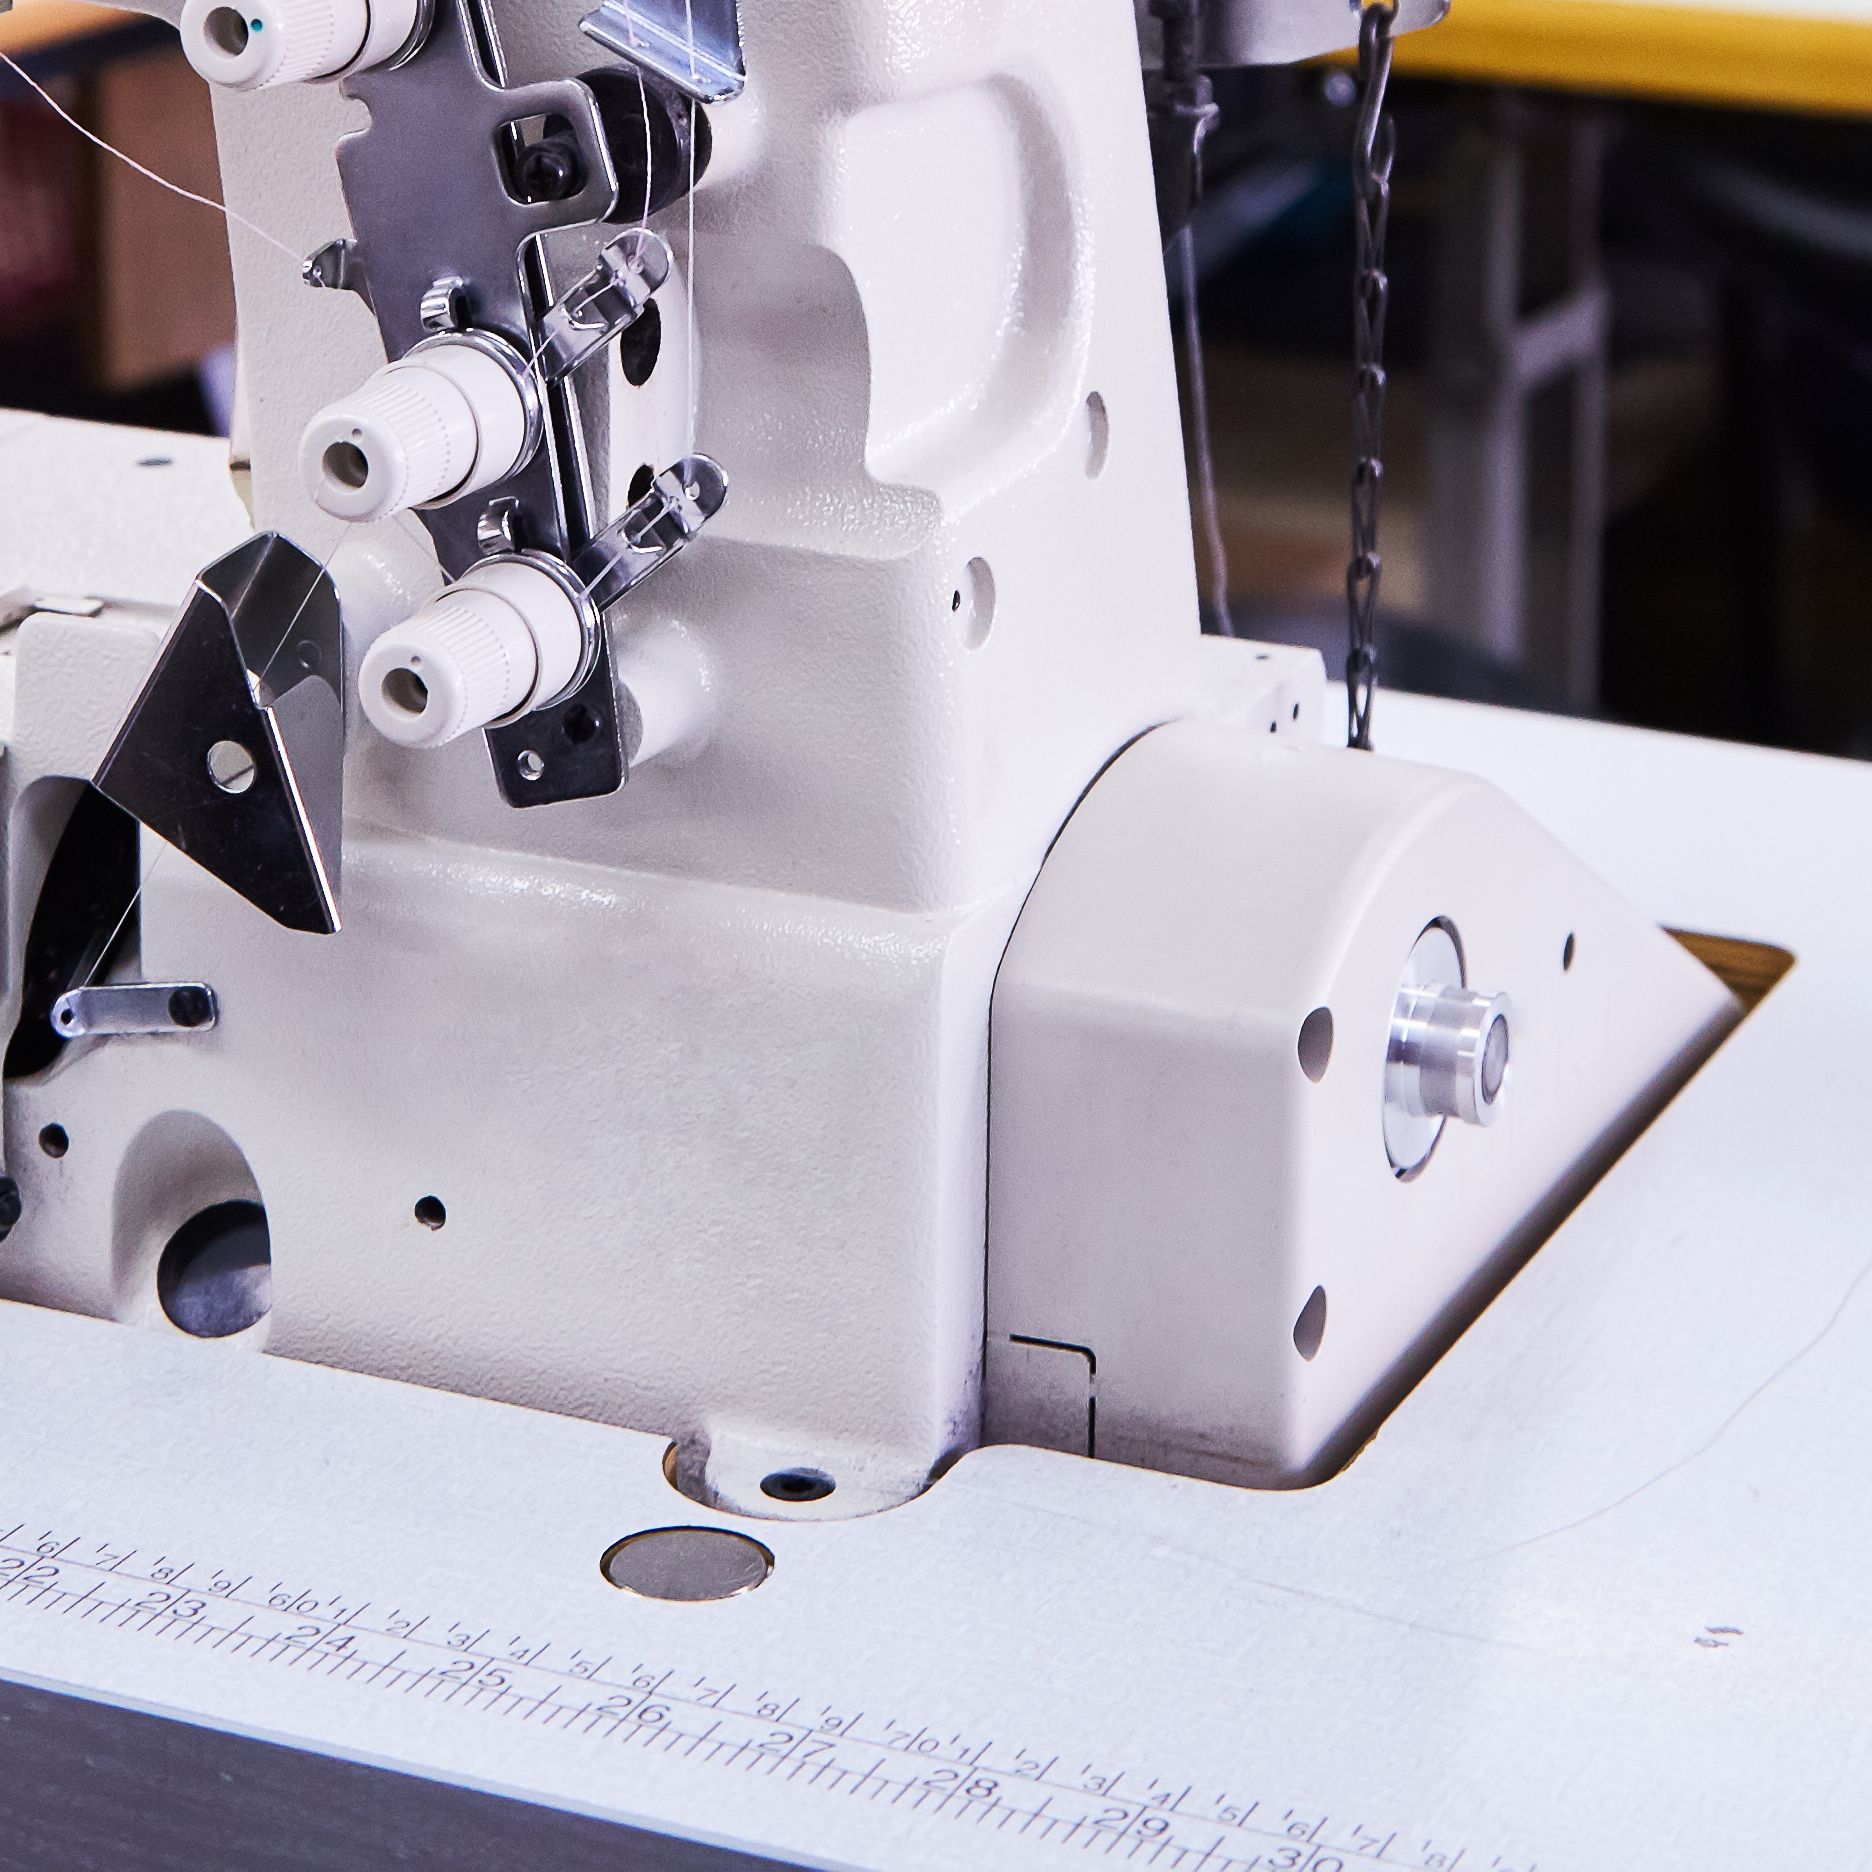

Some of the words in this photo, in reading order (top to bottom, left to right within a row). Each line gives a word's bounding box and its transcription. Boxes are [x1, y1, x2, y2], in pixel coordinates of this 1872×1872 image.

[36, 1540, 60, 1554] 6
[96, 1553, 120, 1566] 7
[150, 1567, 174, 1580] 8
[208, 1579, 232, 1593] 9
[268, 1592, 319, 1613] 60
[333, 1607, 348, 1619] 1
[386, 1620, 411, 1633] 2
[447, 1633, 471, 1648] 3
[509, 1648, 530, 1661] 4
[569, 1660, 595, 1675] 5
[632, 1674, 656, 1689] 6
[696, 1687, 720, 1702] 7
[756, 1702, 779, 1717] 8
[820, 1716, 844, 1730] 9
[887, 1731, 940, 1753] 70
[958, 1747, 972, 1760] 1
[1015, 1760, 1040, 1776] 2
[1083, 1775, 1107, 1791] 3
[1150, 1792, 1173, 1806] 4
[1217, 1806, 1241, 1822] 5
[1287, 1821, 1311, 1838] 6
[1359, 1836, 1381, 1851] 7
[134, 1591, 207, 1618] 23
[285, 1625, 357, 1652] 24
[438, 1660, 513, 1688] 25
[595, 1695, 671, 1724] 26
[757, 1731, 837, 1759] 27
[923, 1769, 999, 1798] 28
[1092, 1808, 1170, 1838] 29
[1268, 1847, 1344, 1872] 30
